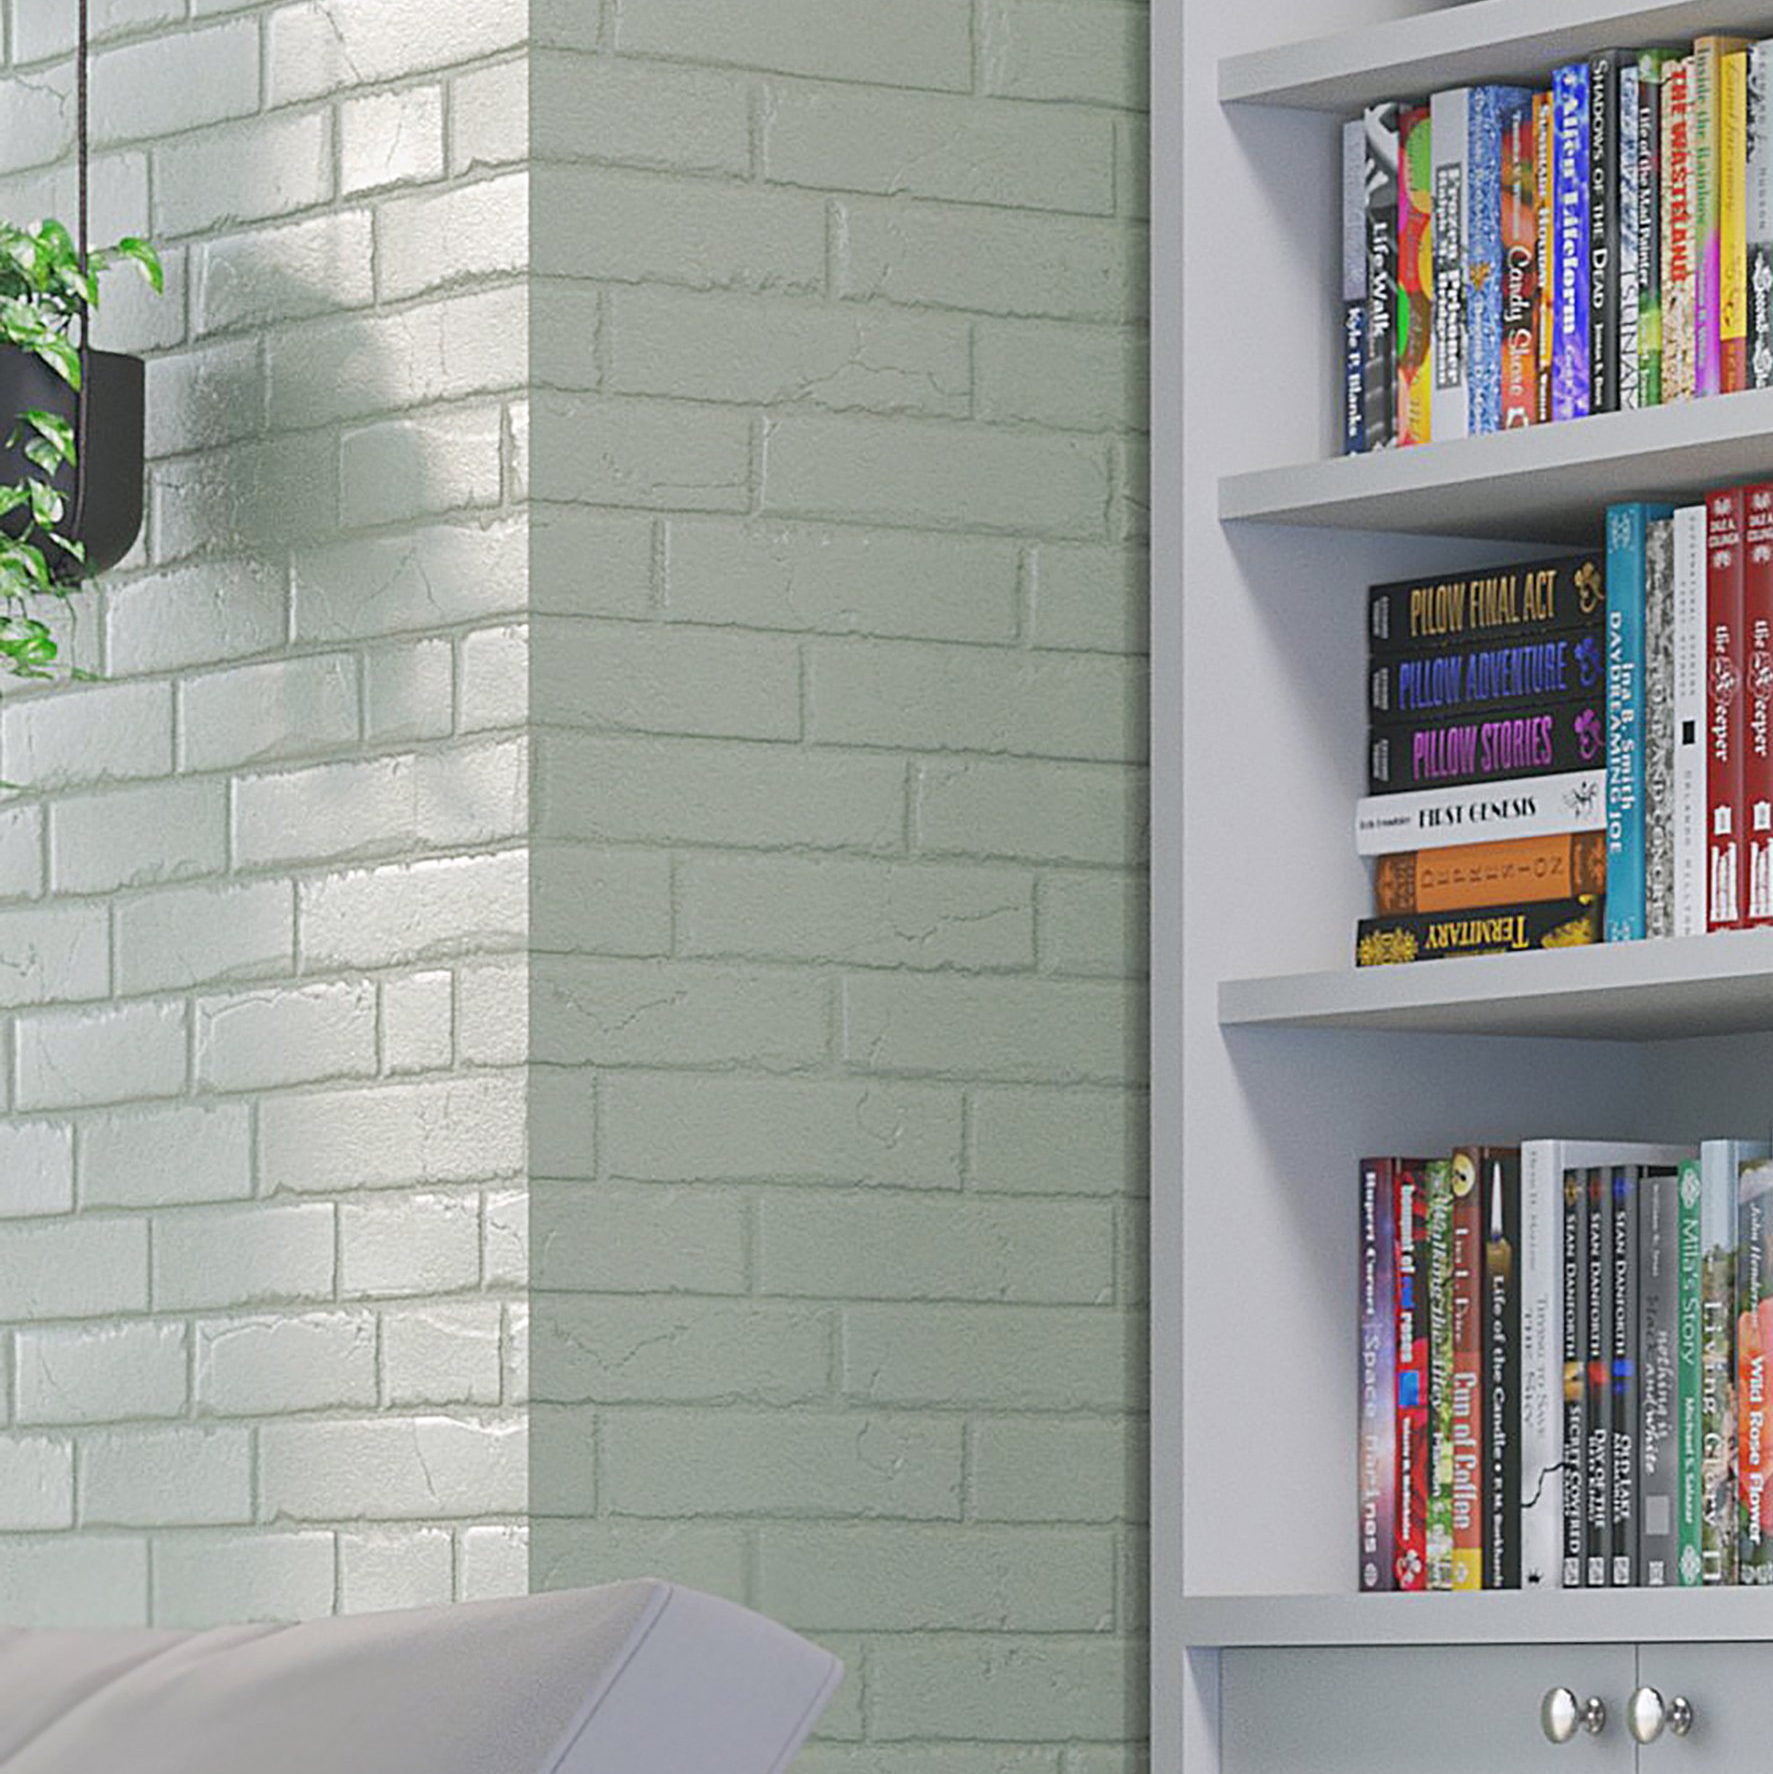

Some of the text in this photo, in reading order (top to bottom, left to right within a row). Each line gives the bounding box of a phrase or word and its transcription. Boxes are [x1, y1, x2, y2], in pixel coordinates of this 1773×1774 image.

[1372, 222, 1388, 337] Life Walk
[1504, 245, 1532, 323] Candy
[1411, 585, 1466, 637] PILOW
[1470, 576, 1520, 627] FINAL
[1523, 569, 1558, 620] ACT
[1400, 655, 1463, 711] PILLOW
[1466, 640, 1568, 702] ADVENTURE
[1412, 724, 1477, 781] PILLOW
[1480, 715, 1553, 772] STORIES
[1609, 612, 1622, 855] DAYDREAMING JOE
[1418, 795, 1537, 828] FIRST GENESIS
[1426, 914, 1528, 950] TERMITARY
[1679, 1218, 1699, 1365] Mila's Story
[1750, 1356, 1766, 1545] Wild Rose Flower
